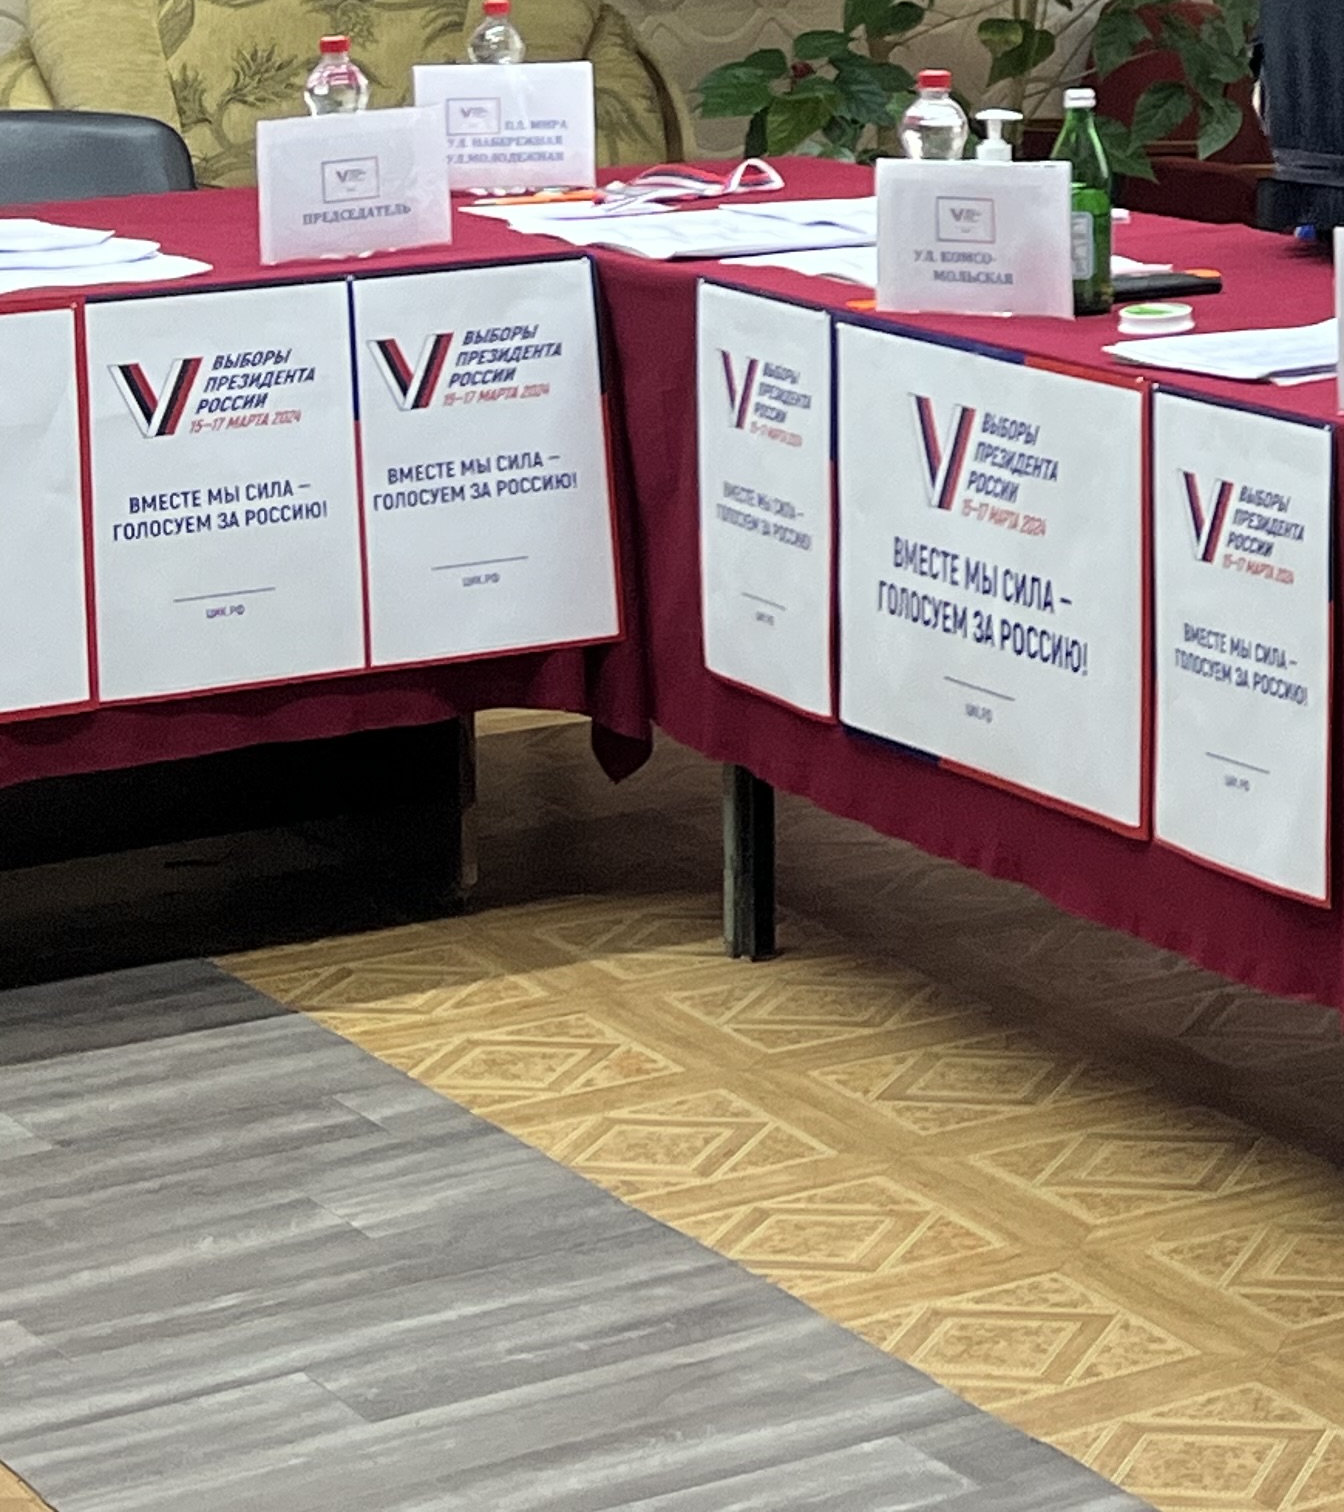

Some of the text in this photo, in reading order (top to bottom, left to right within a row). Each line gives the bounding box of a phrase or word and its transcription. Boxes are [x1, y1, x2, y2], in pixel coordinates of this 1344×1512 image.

[303, 203, 412, 226] ПРЕДСЕДАТЕЛЬ
[932, 269, 1014, 285] МОЛЬСКАЯ
[462, 324, 540, 346] ВЫБОРЫ
[212, 348, 292, 371] ВЫБОРЫ
[455, 342, 562, 367] ПРЕЗИДЕНТА
[203, 367, 316, 393] ПРЕЗИДЕНТА
[448, 367, 517, 388] РОССИИ
[476, 385, 518, 402] МАРТА
[520, 383, 550, 399] 2024
[195, 393, 269, 414] РОССИИ
[226, 413, 269, 430] МАРТА
[271, 409, 301, 425] 2024
[981, 411, 1040, 447] ВЫБОРЫ
[387, 461, 456, 485] ВМЕСТЕ
[460, 457, 491, 476] МЫ
[496, 451, 544, 472] СИЛА
[974, 441, 1059, 483] ПРЕЗИДЕНТА
[129, 489, 202, 514] ВМЕСТЕ
[208, 486, 240, 506] МЫ
[245, 479, 294, 502] СИЛА
[373, 472, 577, 512] ГОЛОСУЕМ ЗА РОССИЮ!
[967, 470, 1020, 504] РОССИИ
[1239, 485, 1292, 514] ВЫБОРЫ
[113, 500, 328, 542] ГОЛОСУЕМ ЗА РОССИЮ!
[1232, 508, 1305, 543] ПРЕЗИДЕНТА
[1226, 532, 1275, 558] РОССИИ
[893, 536, 961, 587] ВМЕСТЕ
[964, 557, 998, 598] МЫ
[1002, 568, 1055, 614] СИЛА
[877, 580, 1089, 676] ГОЛОСУЕМ ЗА РОССИЮ!
[1184, 622, 1227, 655] ВМЕСТЕ
[1229, 637, 1252, 661] МЫ
[1254, 642, 1288, 670] СИЛА
[1174, 647, 1309, 707] ГОЛОСУЕМ ЗА РОССИЮ!
